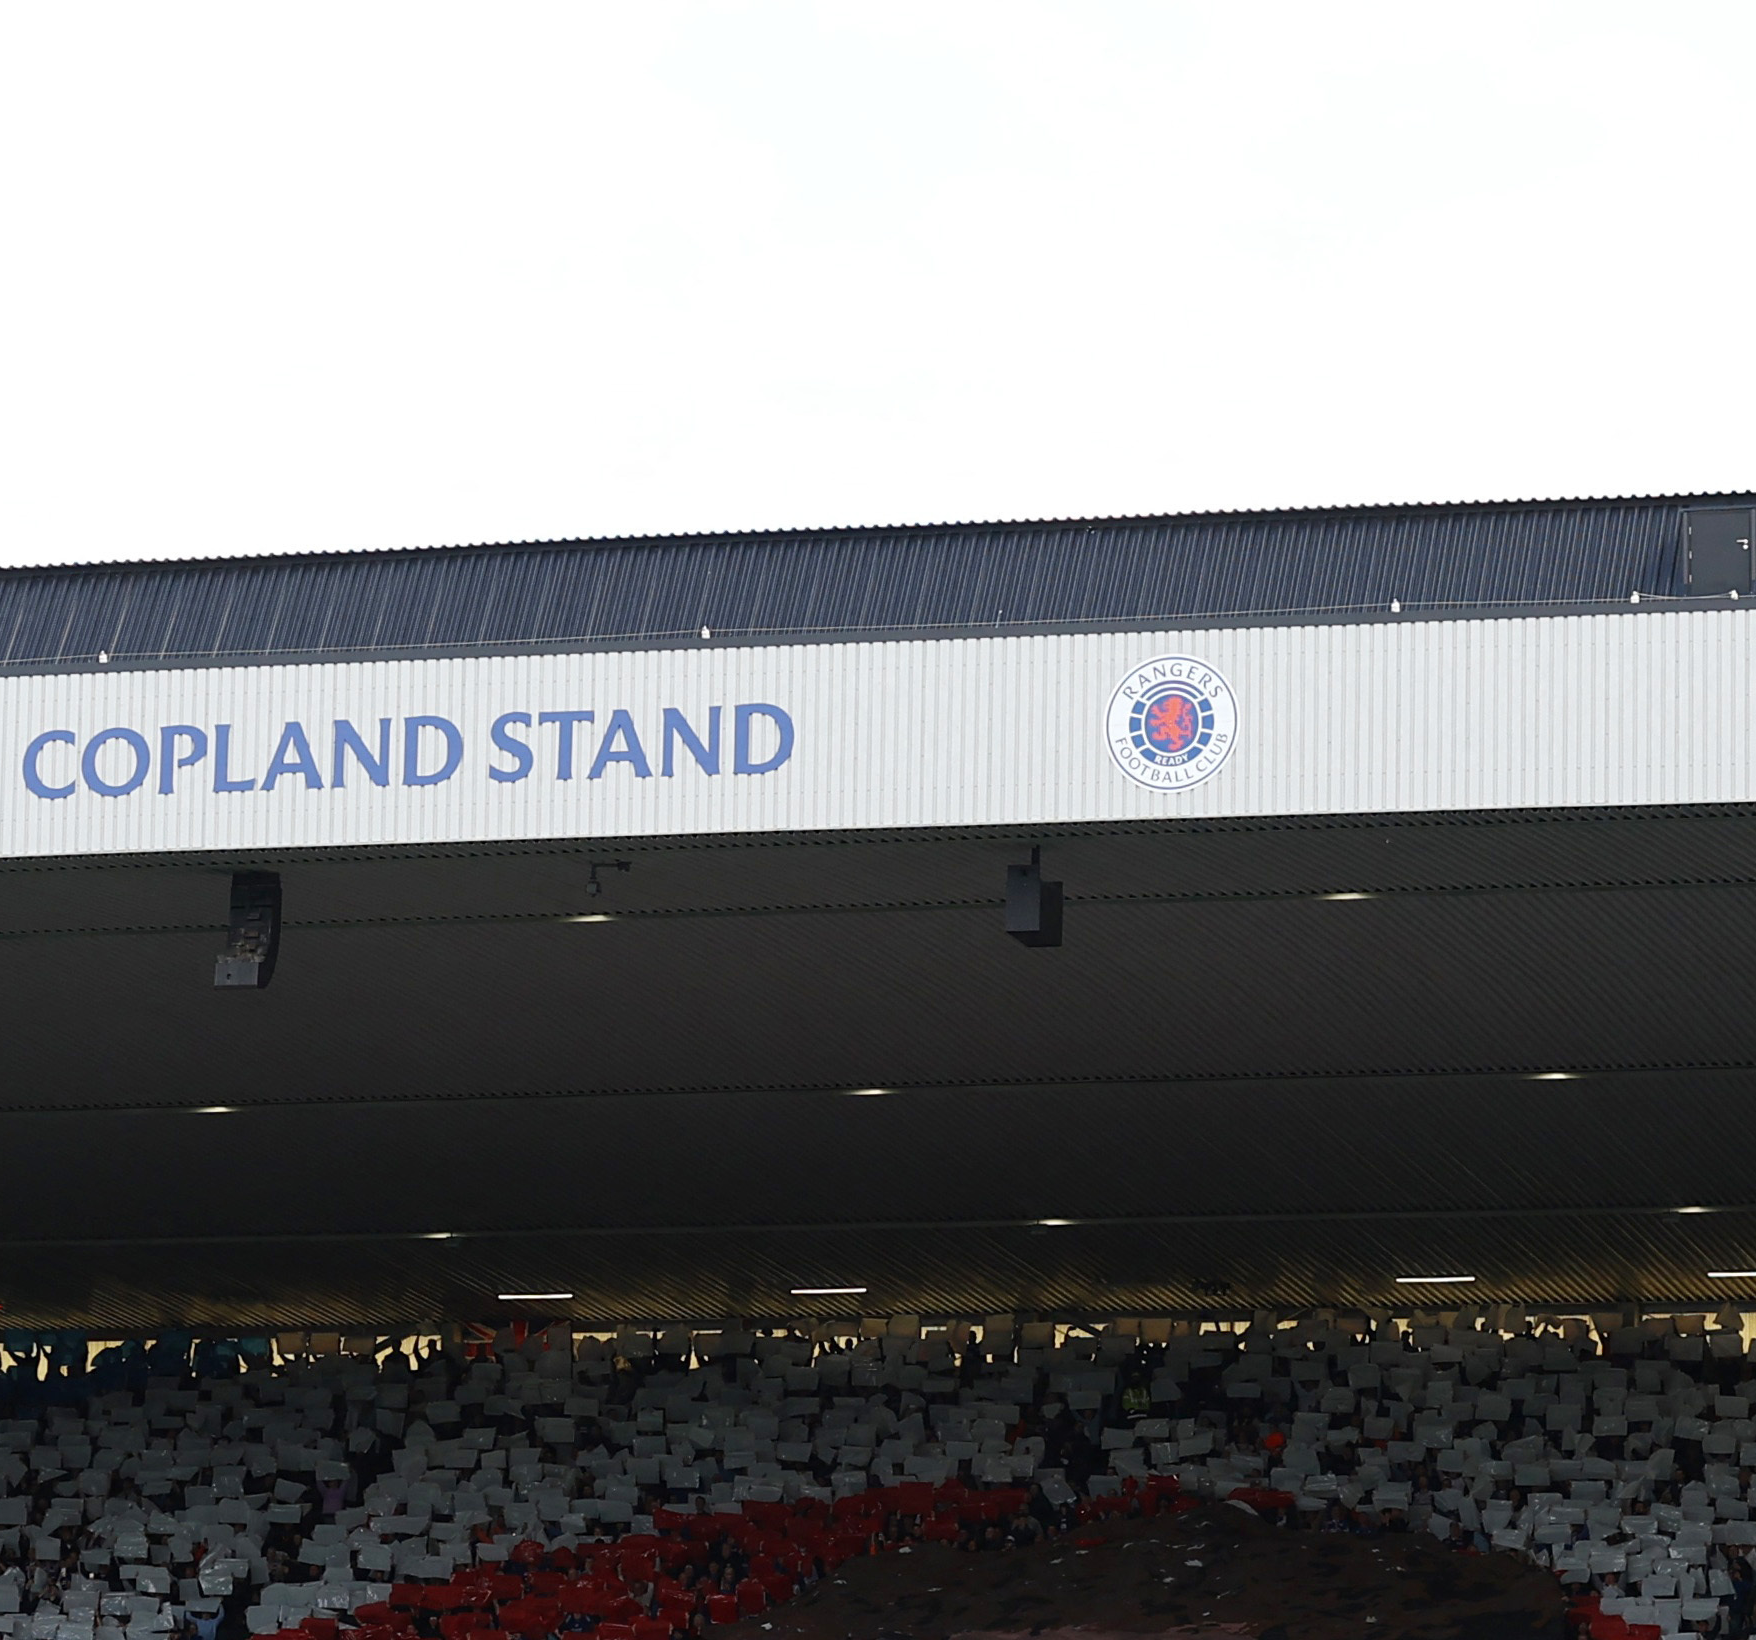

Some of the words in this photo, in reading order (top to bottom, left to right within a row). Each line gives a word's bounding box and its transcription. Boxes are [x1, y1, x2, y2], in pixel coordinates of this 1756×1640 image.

[1122, 662, 1224, 700] RANGERS
[21, 714, 464, 800] COPLAND
[488, 703, 795, 783] STAND
[1115, 737, 1194, 783] FOOTBALL
[1195, 733, 1228, 773] CLUB
[1154, 753, 1189, 766] READY
